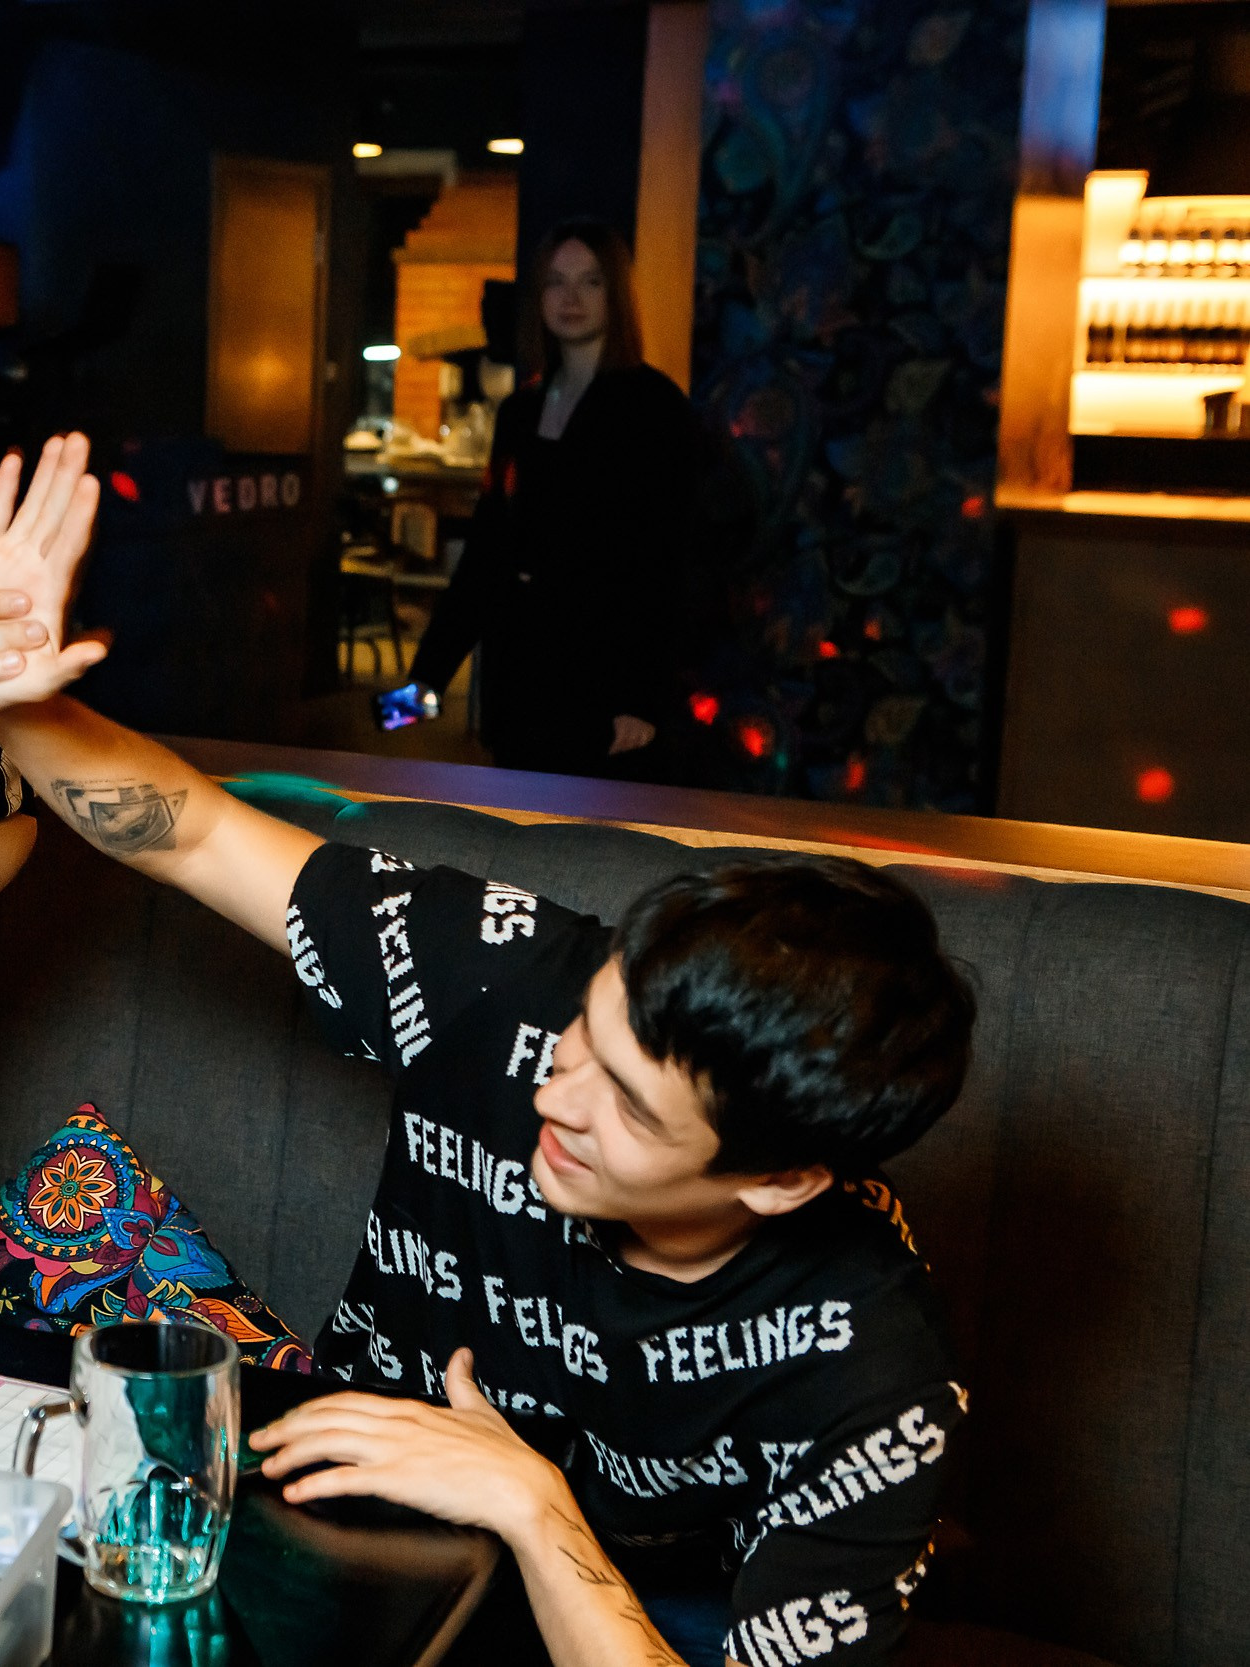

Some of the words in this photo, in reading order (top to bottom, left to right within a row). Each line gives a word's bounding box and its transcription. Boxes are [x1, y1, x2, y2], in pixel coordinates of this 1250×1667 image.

[187, 473, 301, 514] VEDRO
[367, 1209, 463, 1302] ELINGS
[636, 1299, 855, 1383] FEELINGS
[584, 1430, 749, 1498] FEELINGS
